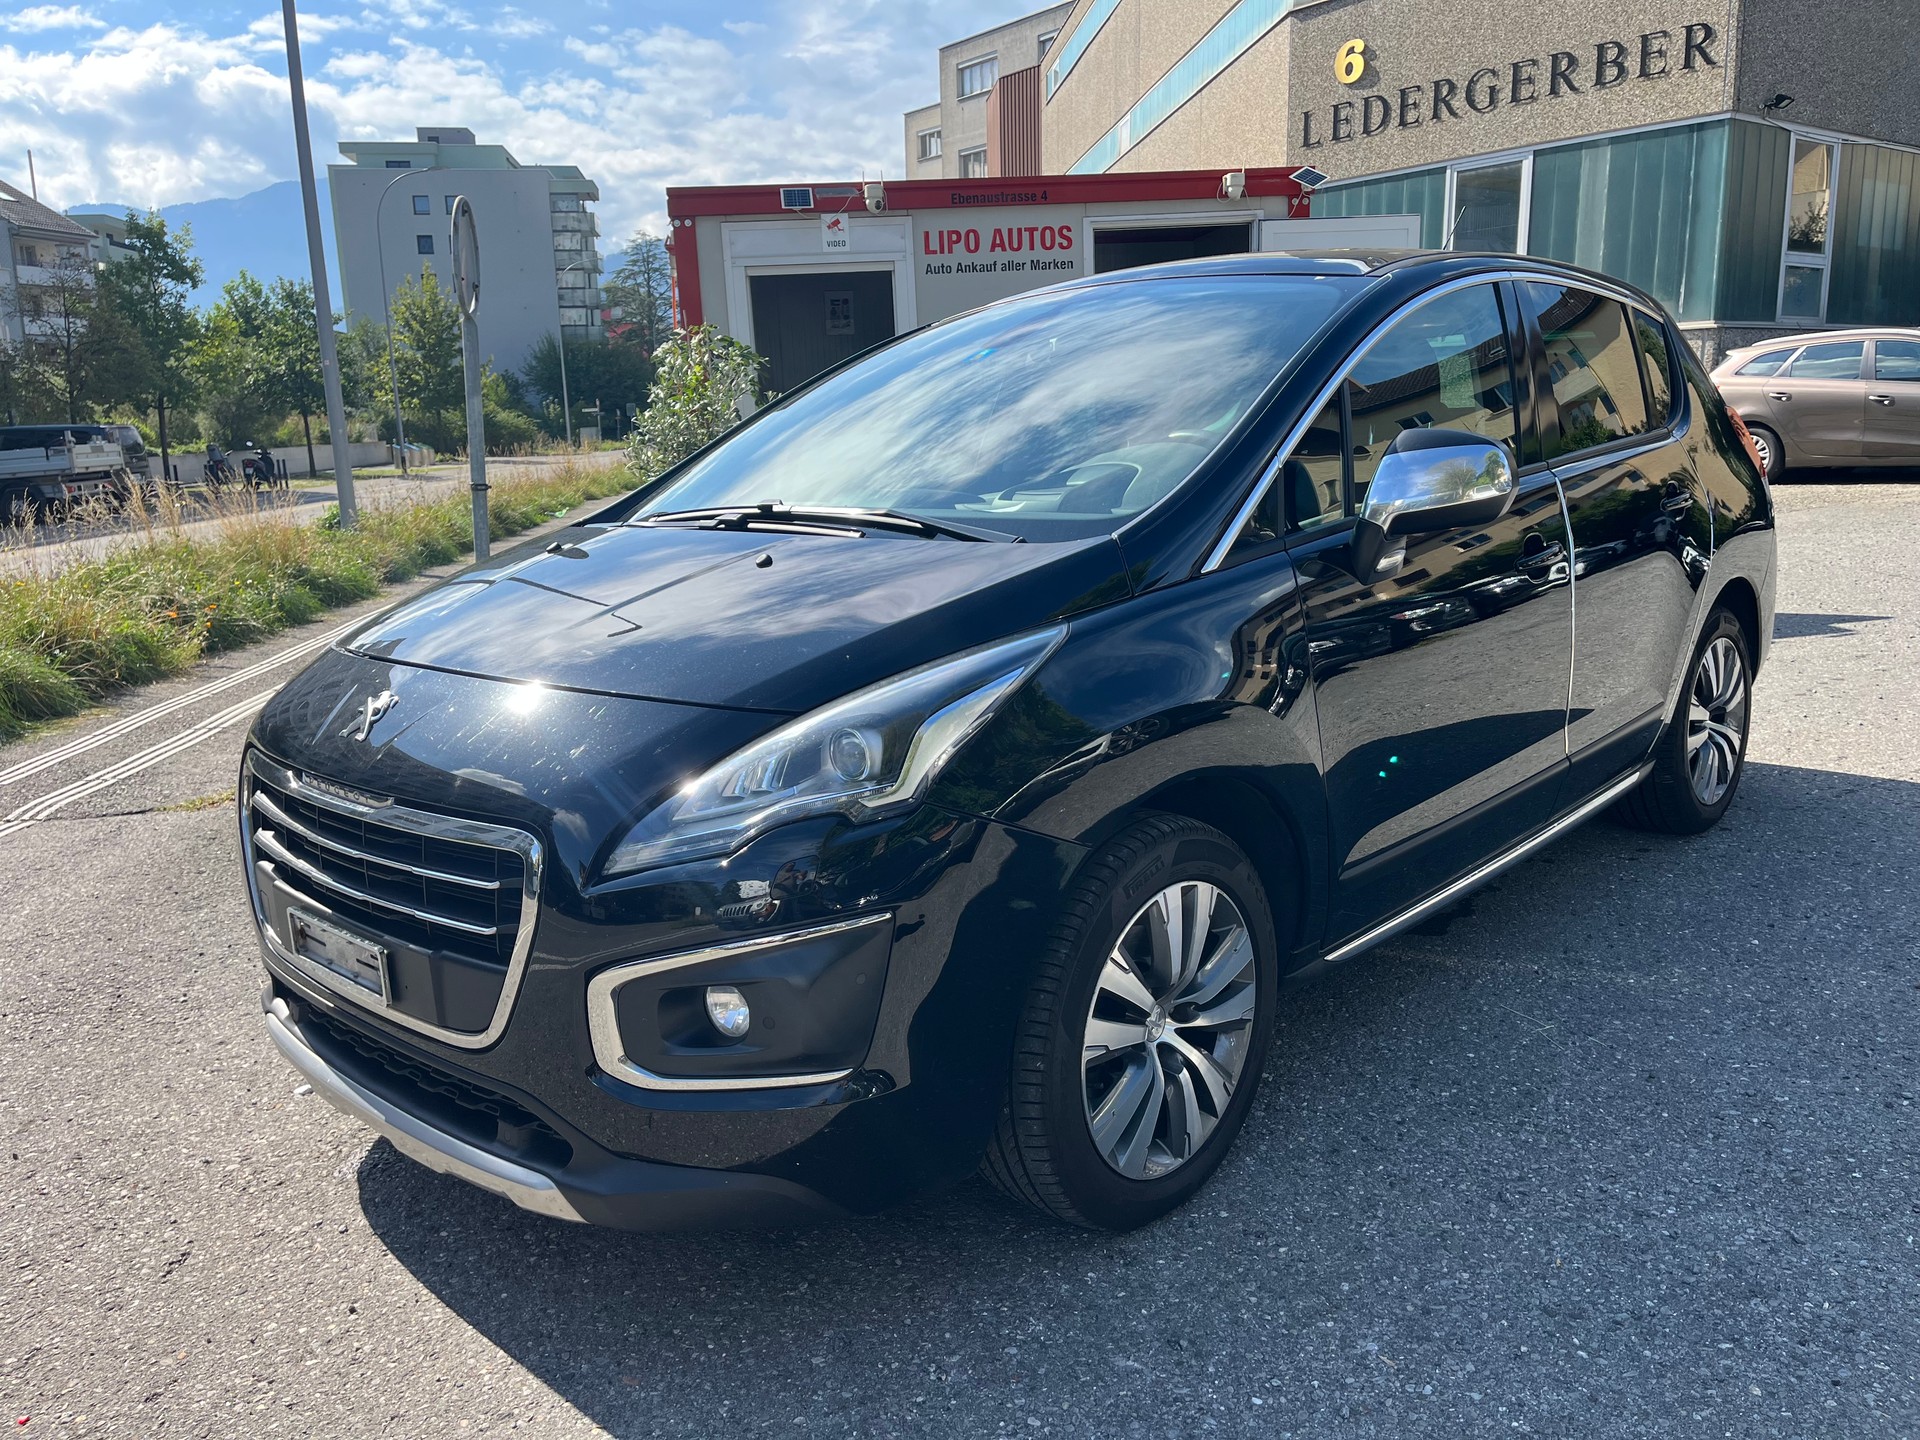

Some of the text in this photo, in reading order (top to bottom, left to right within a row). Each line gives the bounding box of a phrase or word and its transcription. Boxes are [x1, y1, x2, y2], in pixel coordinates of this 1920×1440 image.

[1336, 38, 1366, 84] 6
[1301, 21, 1718, 148] LEDERGERBER
[951, 190, 1049, 205] Ebenaustrasse 4
[826, 240, 847, 248] VIDEO
[923, 225, 1073, 255] LIPO AUTOS
[925, 258, 1074, 275] Auto Ankauf aller Marken
[308, 776, 371, 803] PEUGEOT
